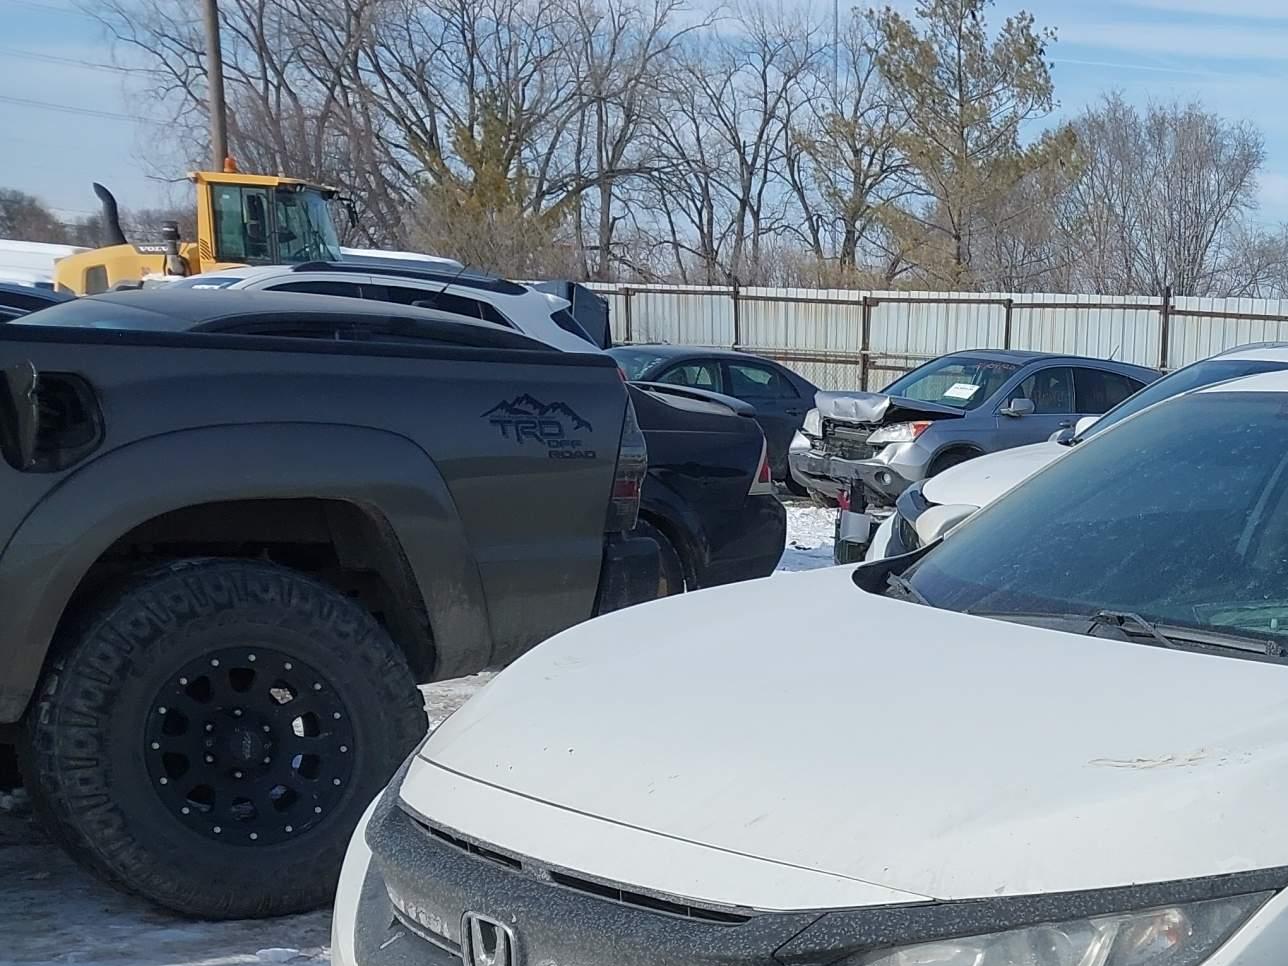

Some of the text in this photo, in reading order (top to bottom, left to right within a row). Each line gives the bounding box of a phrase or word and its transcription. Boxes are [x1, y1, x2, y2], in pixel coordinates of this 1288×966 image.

[489, 419, 565, 444] TRD
[547, 440, 582, 449] OFF
[547, 450, 597, 459] ROAD
